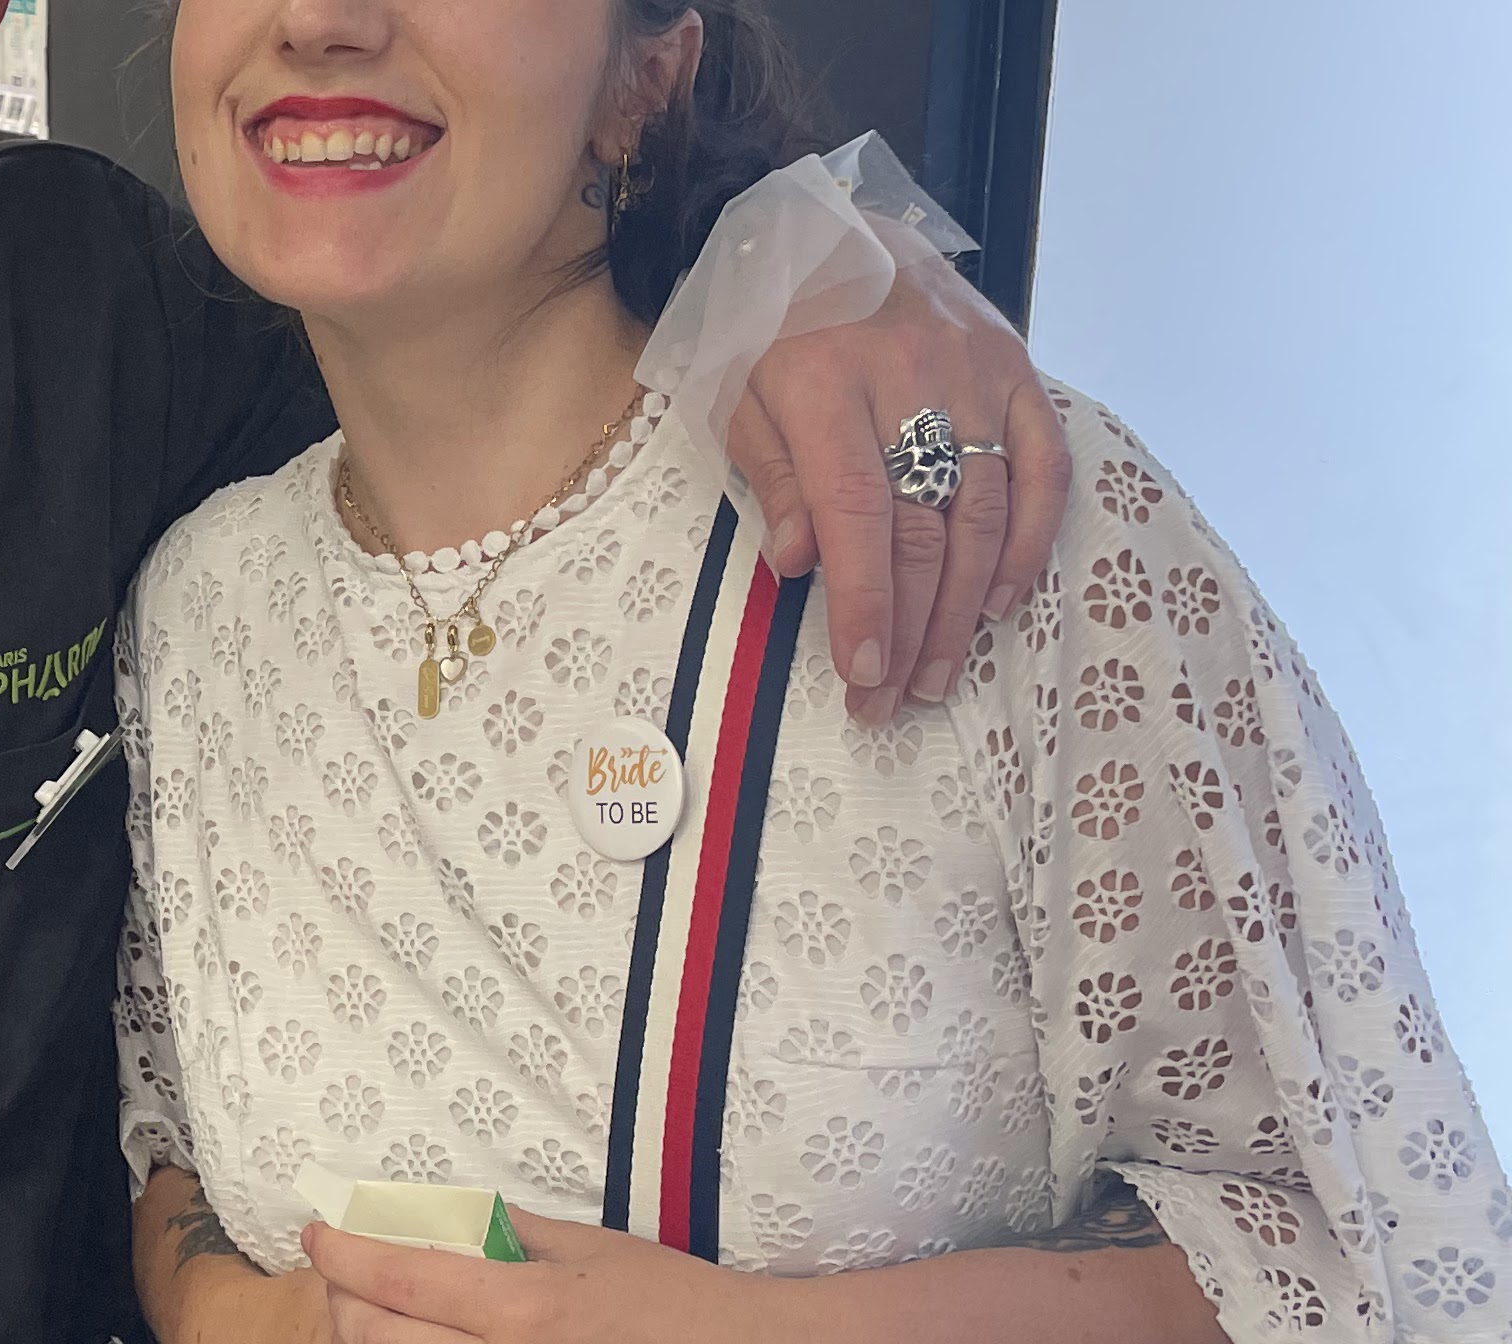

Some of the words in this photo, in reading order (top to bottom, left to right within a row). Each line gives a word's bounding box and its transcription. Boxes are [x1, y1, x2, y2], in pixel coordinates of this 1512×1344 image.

[586, 745, 667, 796] Bride
[596, 802, 624, 824] TO
[632, 802, 658, 824] BE
